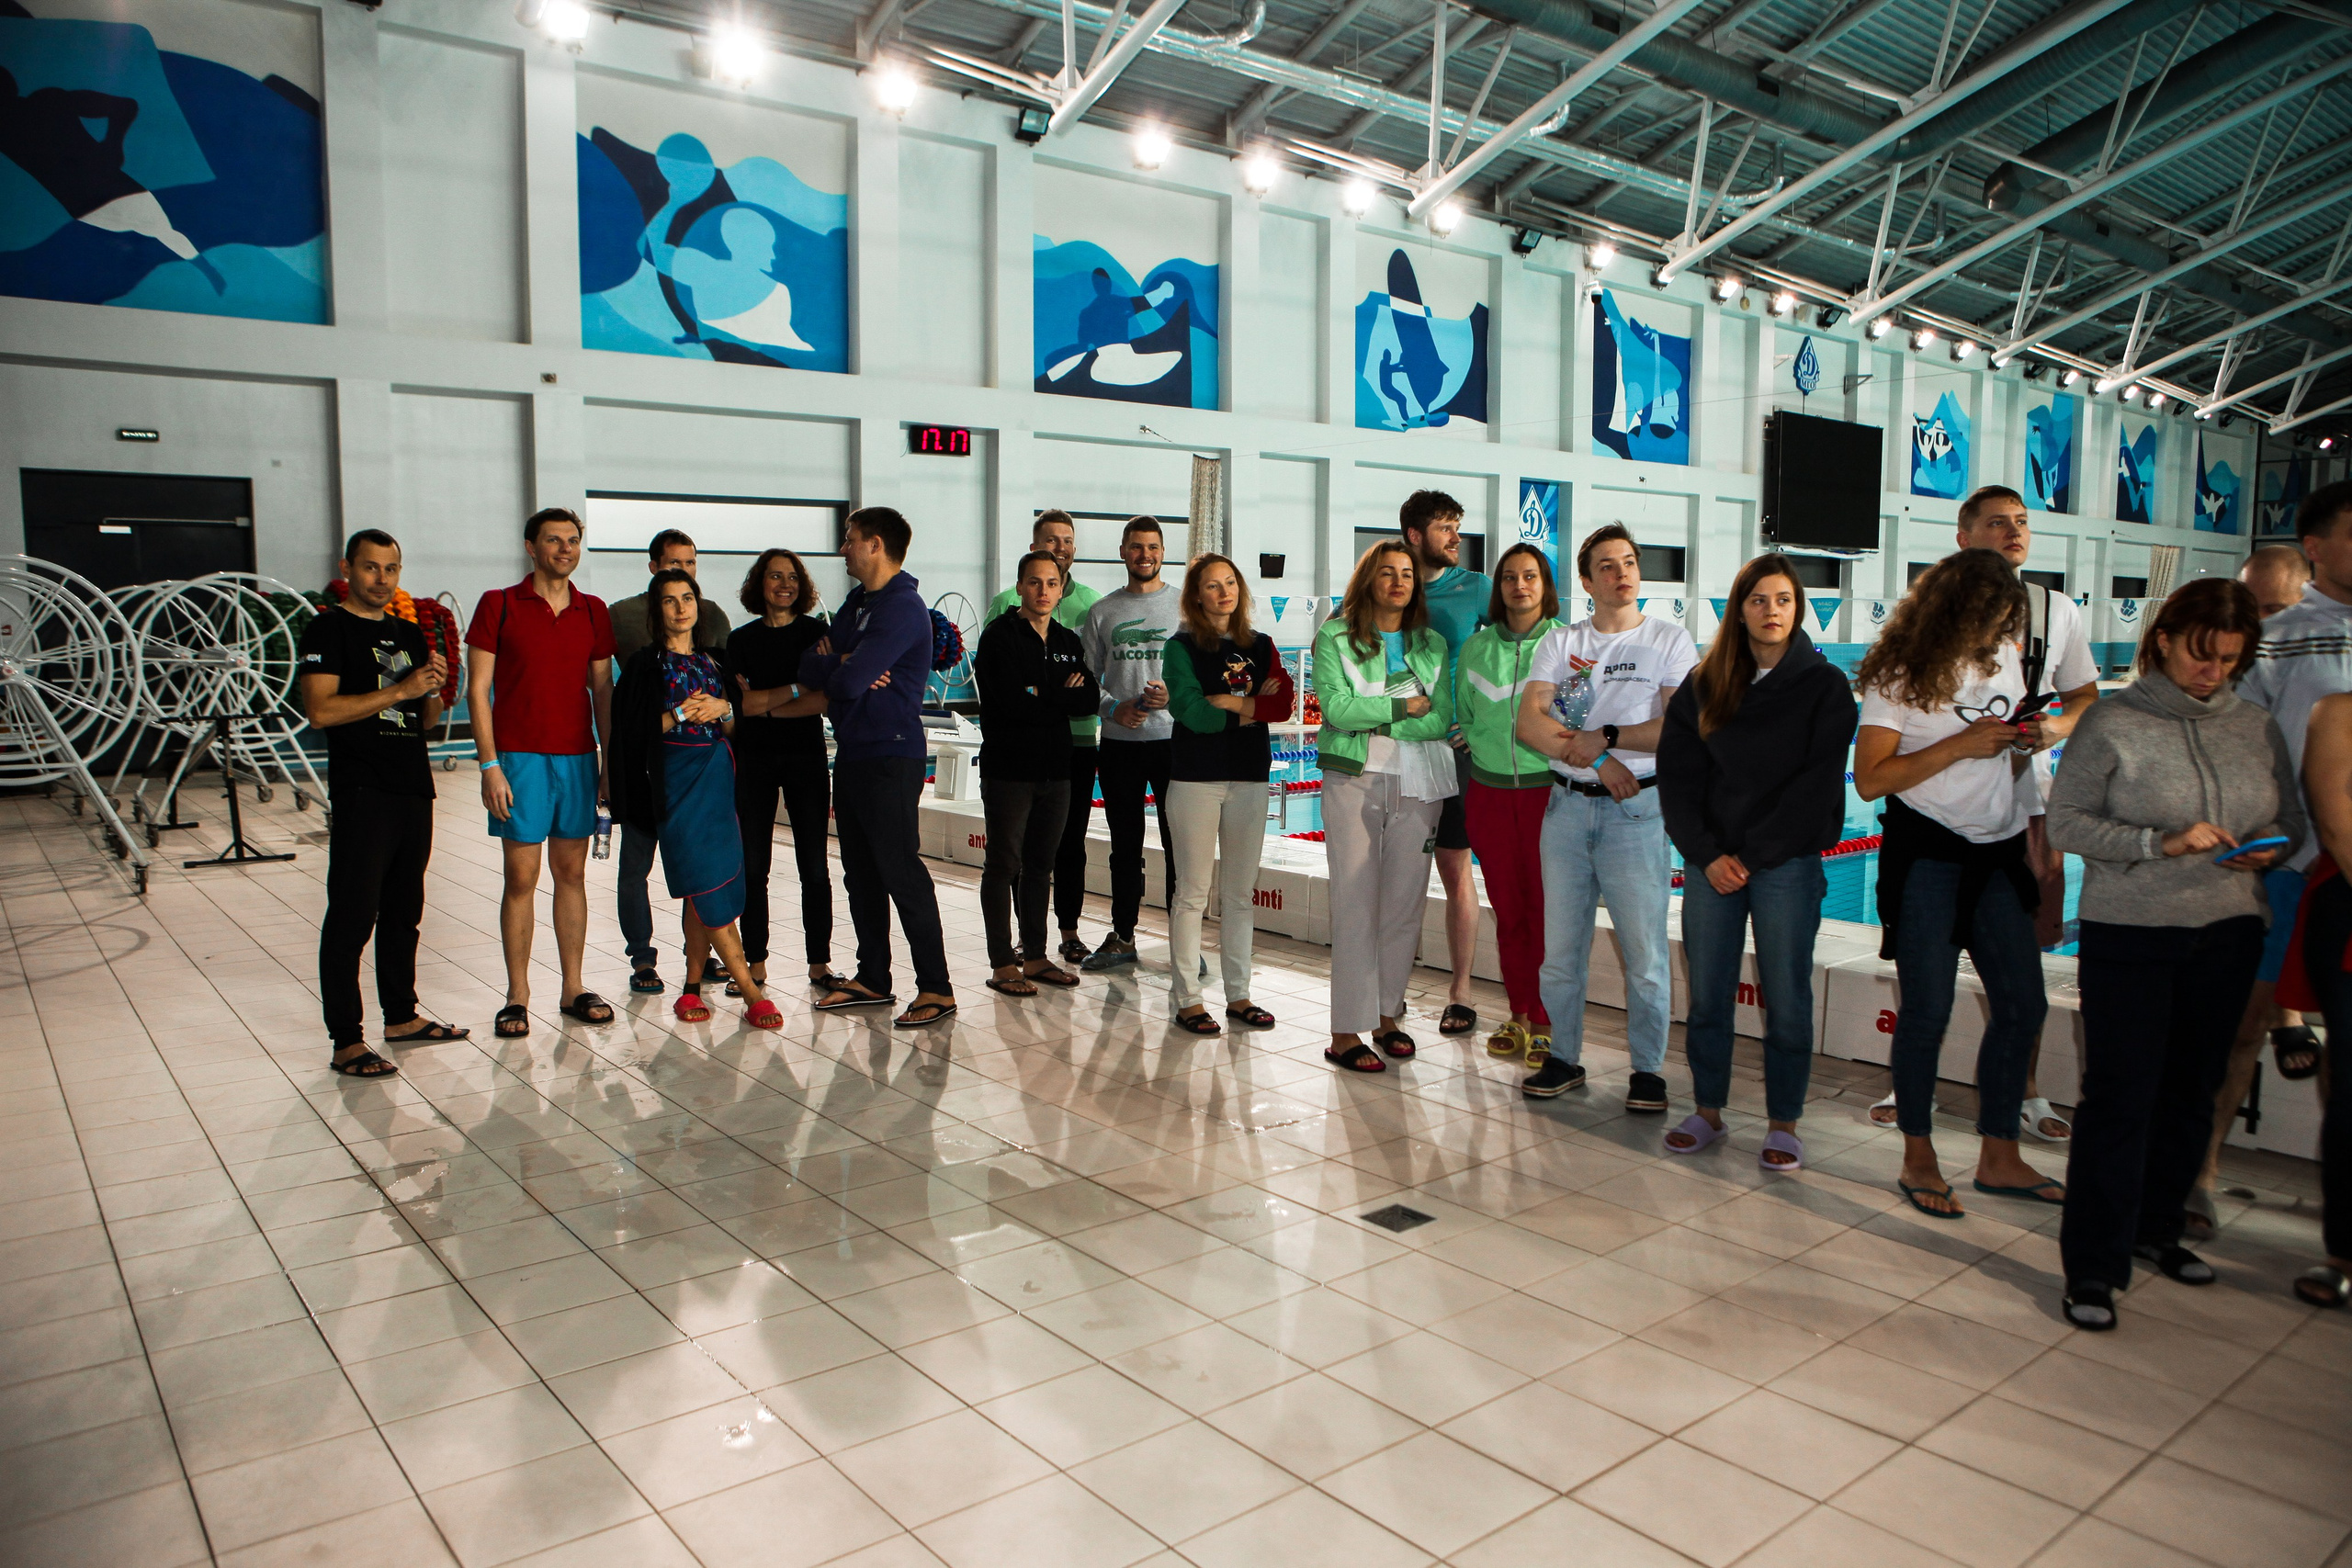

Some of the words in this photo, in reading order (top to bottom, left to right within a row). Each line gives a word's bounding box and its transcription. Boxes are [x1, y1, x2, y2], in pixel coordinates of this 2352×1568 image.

[1802, 378, 1815, 389] МГО
[968, 833, 987, 850] ant
[1251, 887, 1283, 910] anti
